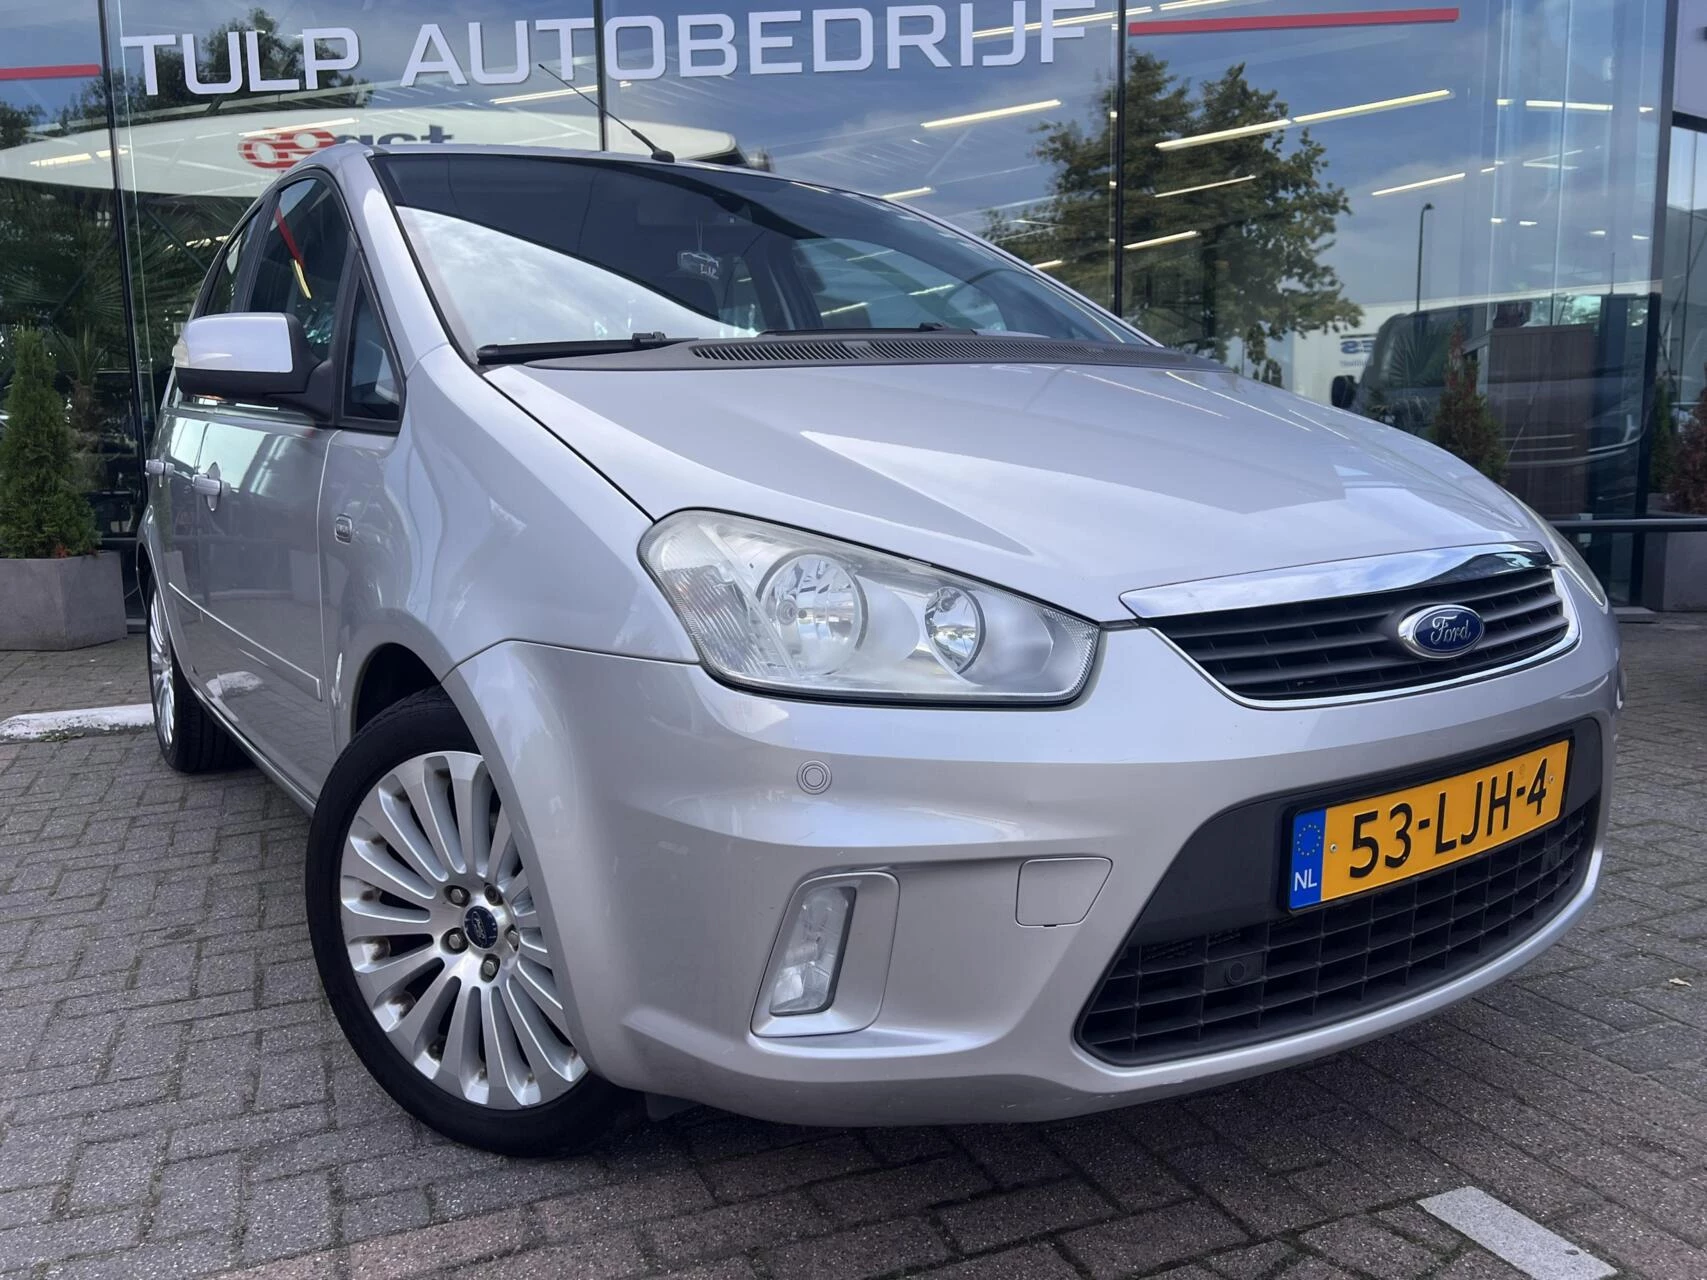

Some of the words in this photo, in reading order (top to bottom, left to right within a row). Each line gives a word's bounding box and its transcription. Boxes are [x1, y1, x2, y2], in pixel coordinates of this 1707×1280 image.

[121, 27, 360, 96] TULP
[399, 0, 1096, 88] AUTOBEDRIJF
[1430, 614, 1472, 646] Ford
[1349, 757, 1548, 879] 53-LJH-4
[1294, 869, 1318, 892] NL
